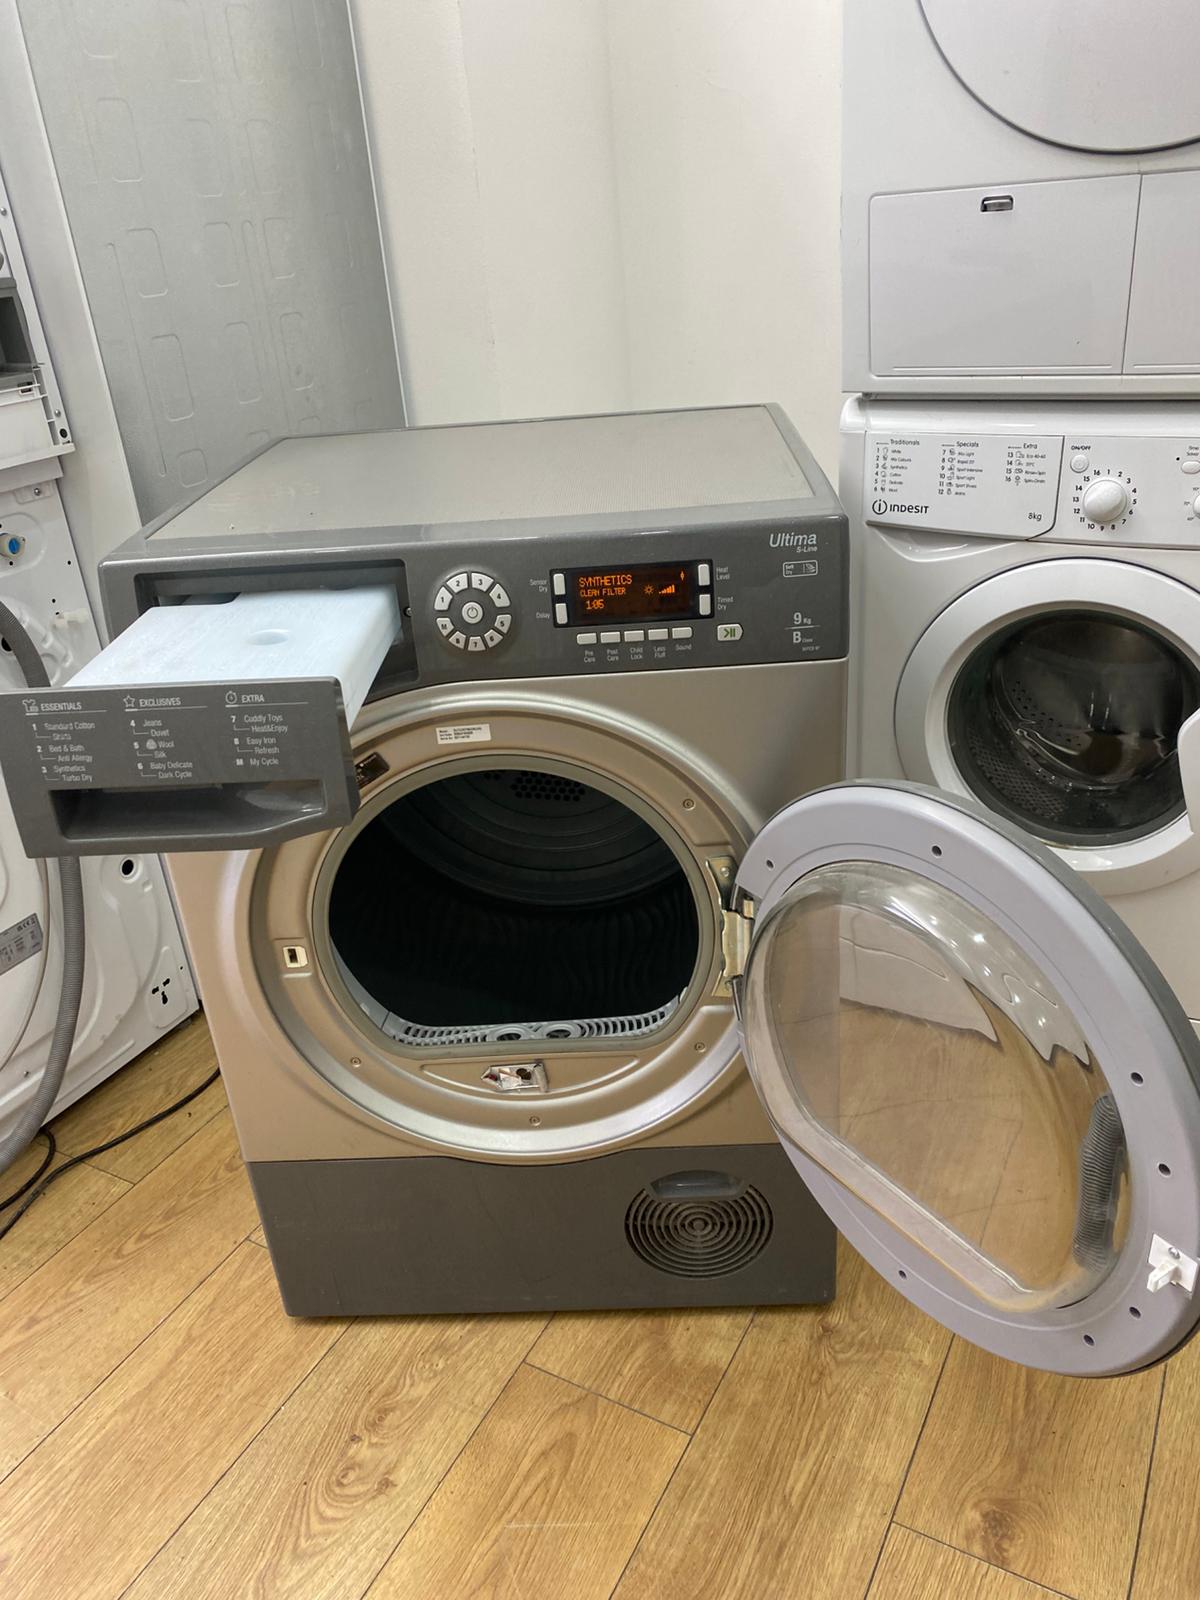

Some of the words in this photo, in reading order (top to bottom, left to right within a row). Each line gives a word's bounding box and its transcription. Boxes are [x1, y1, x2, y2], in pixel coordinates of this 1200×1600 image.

[889, 504, 930, 514] INDESIT
[1027, 512, 1042, 521] 8kg
[769, 532, 817, 548] Ultima
[796, 545, 818, 553] S-Line
[579, 574, 633, 588] SYNTHETICS
[716, 573, 730, 581] Level
[580, 589, 600, 598] CLEAN
[602, 587, 627, 596] FILTER
[586, 599, 605, 610] 1:05
[718, 603, 727, 611] Dry
[793, 612, 802, 625] 9
[793, 631, 802, 643] B
[675, 643, 692, 651] Sound
[139, 697, 181, 708] EXCLUSIVES
[241, 694, 265, 704] EXTRA
[40, 702, 82, 712] ESSENTIALS
[143, 719, 163, 727] Jeans
[243, 714, 267, 724] Cuddly
[267, 713, 284, 723] Toys
[150, 729, 170, 737] Duvet
[158, 740, 175, 749] Wool
[246, 736, 262, 746] Easy
[254, 746, 280, 754] Refresh
[150, 762, 166, 771] Baby
[166, 761, 193, 769] Delicate
[249, 758, 260, 767] My
[261, 757, 280, 767] Cycle
[81, 774, 93, 783] Dry
[158, 771, 173, 779] Dark
[174, 771, 193, 780] Cycle
